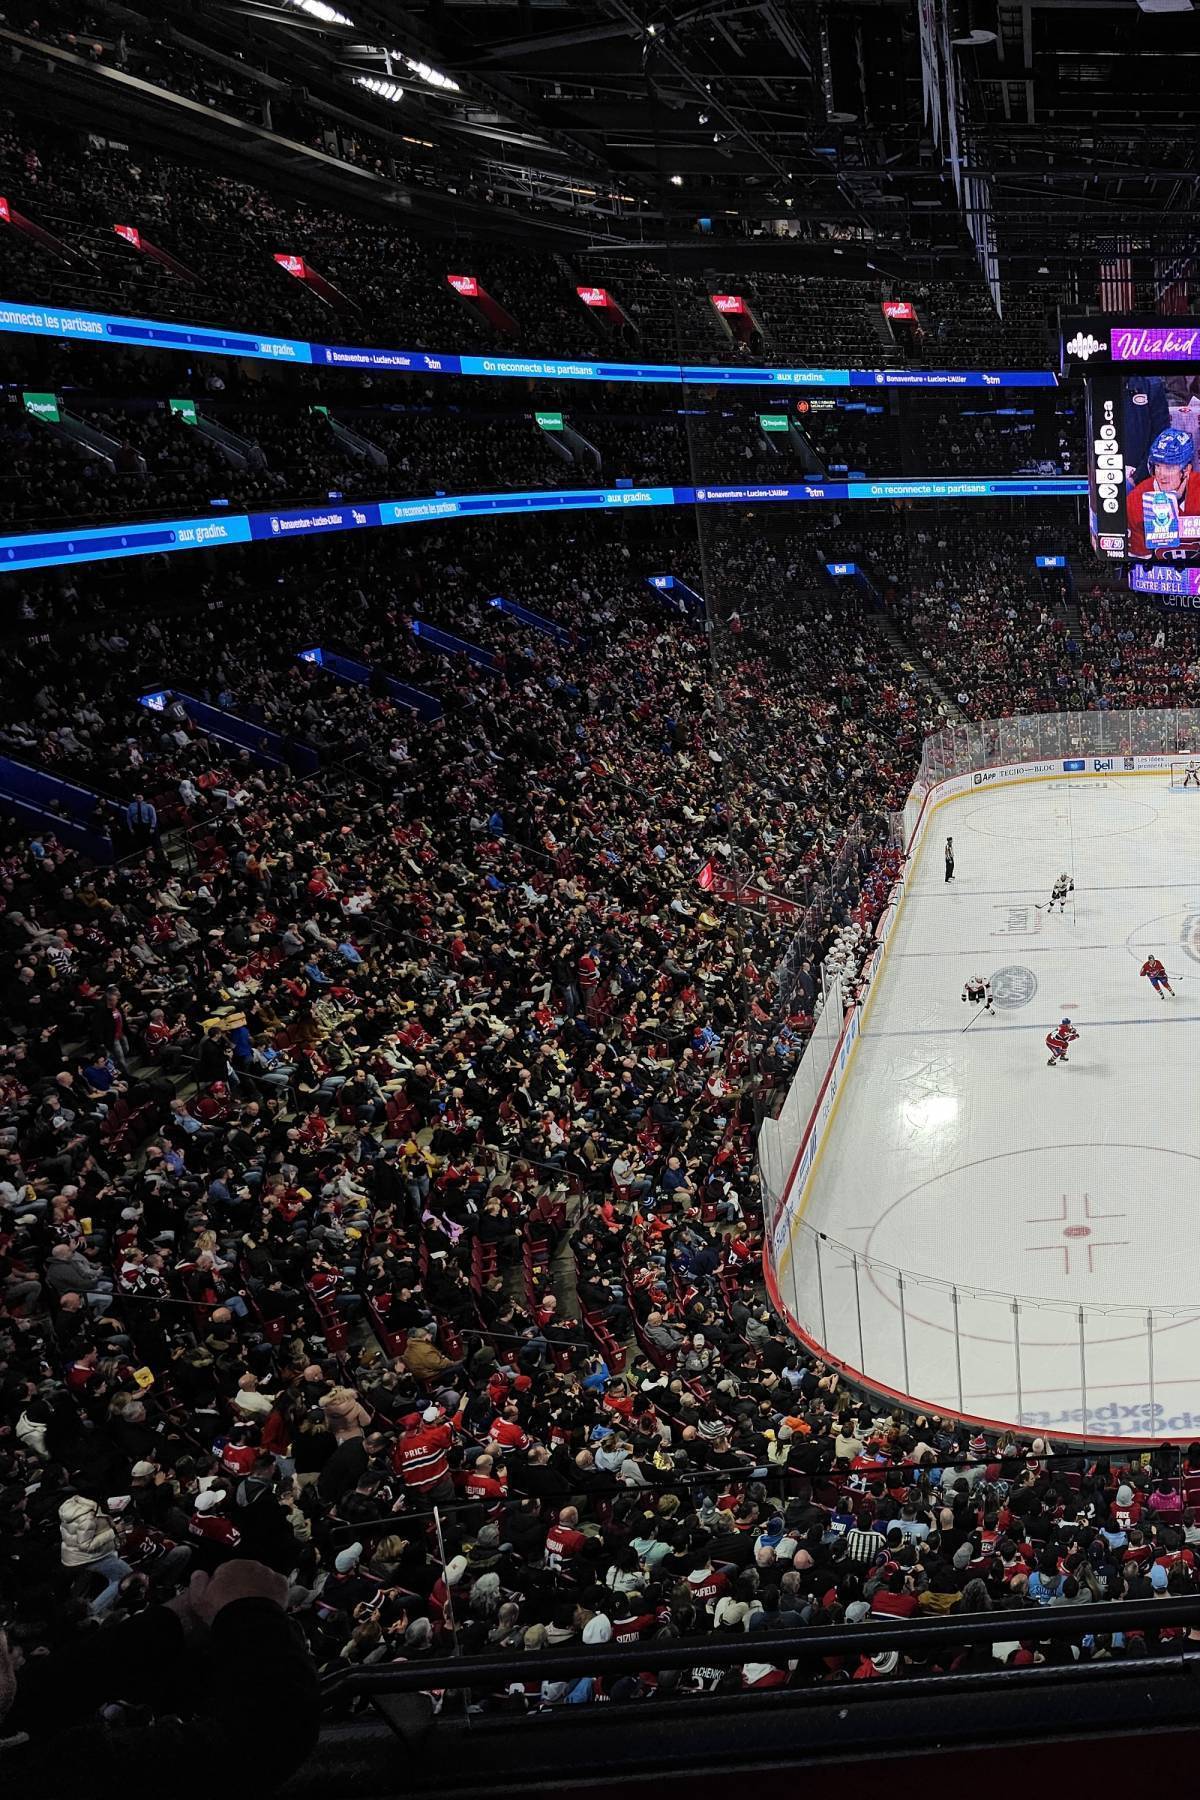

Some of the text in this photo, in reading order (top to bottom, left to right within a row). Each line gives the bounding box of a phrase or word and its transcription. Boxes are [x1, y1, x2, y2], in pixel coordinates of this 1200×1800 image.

[44, 313, 296, 358] les partisans aux gradins.
[1117, 330, 1199, 360] Wizkid
[333, 352, 370, 364] Bonaventure
[428, 357, 443, 369] stm
[483, 360, 825, 384] On reconnecte les partisans aux gradins.
[886, 375, 922, 384] Bonaventure
[986, 376, 1001, 386] stm
[707, 490, 743, 499] Bonaventure
[809, 489, 825, 498] stm
[871, 484, 986, 496] On reconnecte les partisans
[394, 505, 402, 517] On
[402, 504, 429, 517] reconnecte
[436, 502, 457, 515] partisans
[607, 495, 621, 503] aux
[623, 493, 652, 505] gradins.
[280, 517, 311, 530] Bonaventure
[178, 525, 228, 544] aux gradins.
[1094, 759, 1113, 772] Bell
[1017, 1402, 1164, 1427] experts
[404, 1445, 428, 1459] PRICE
